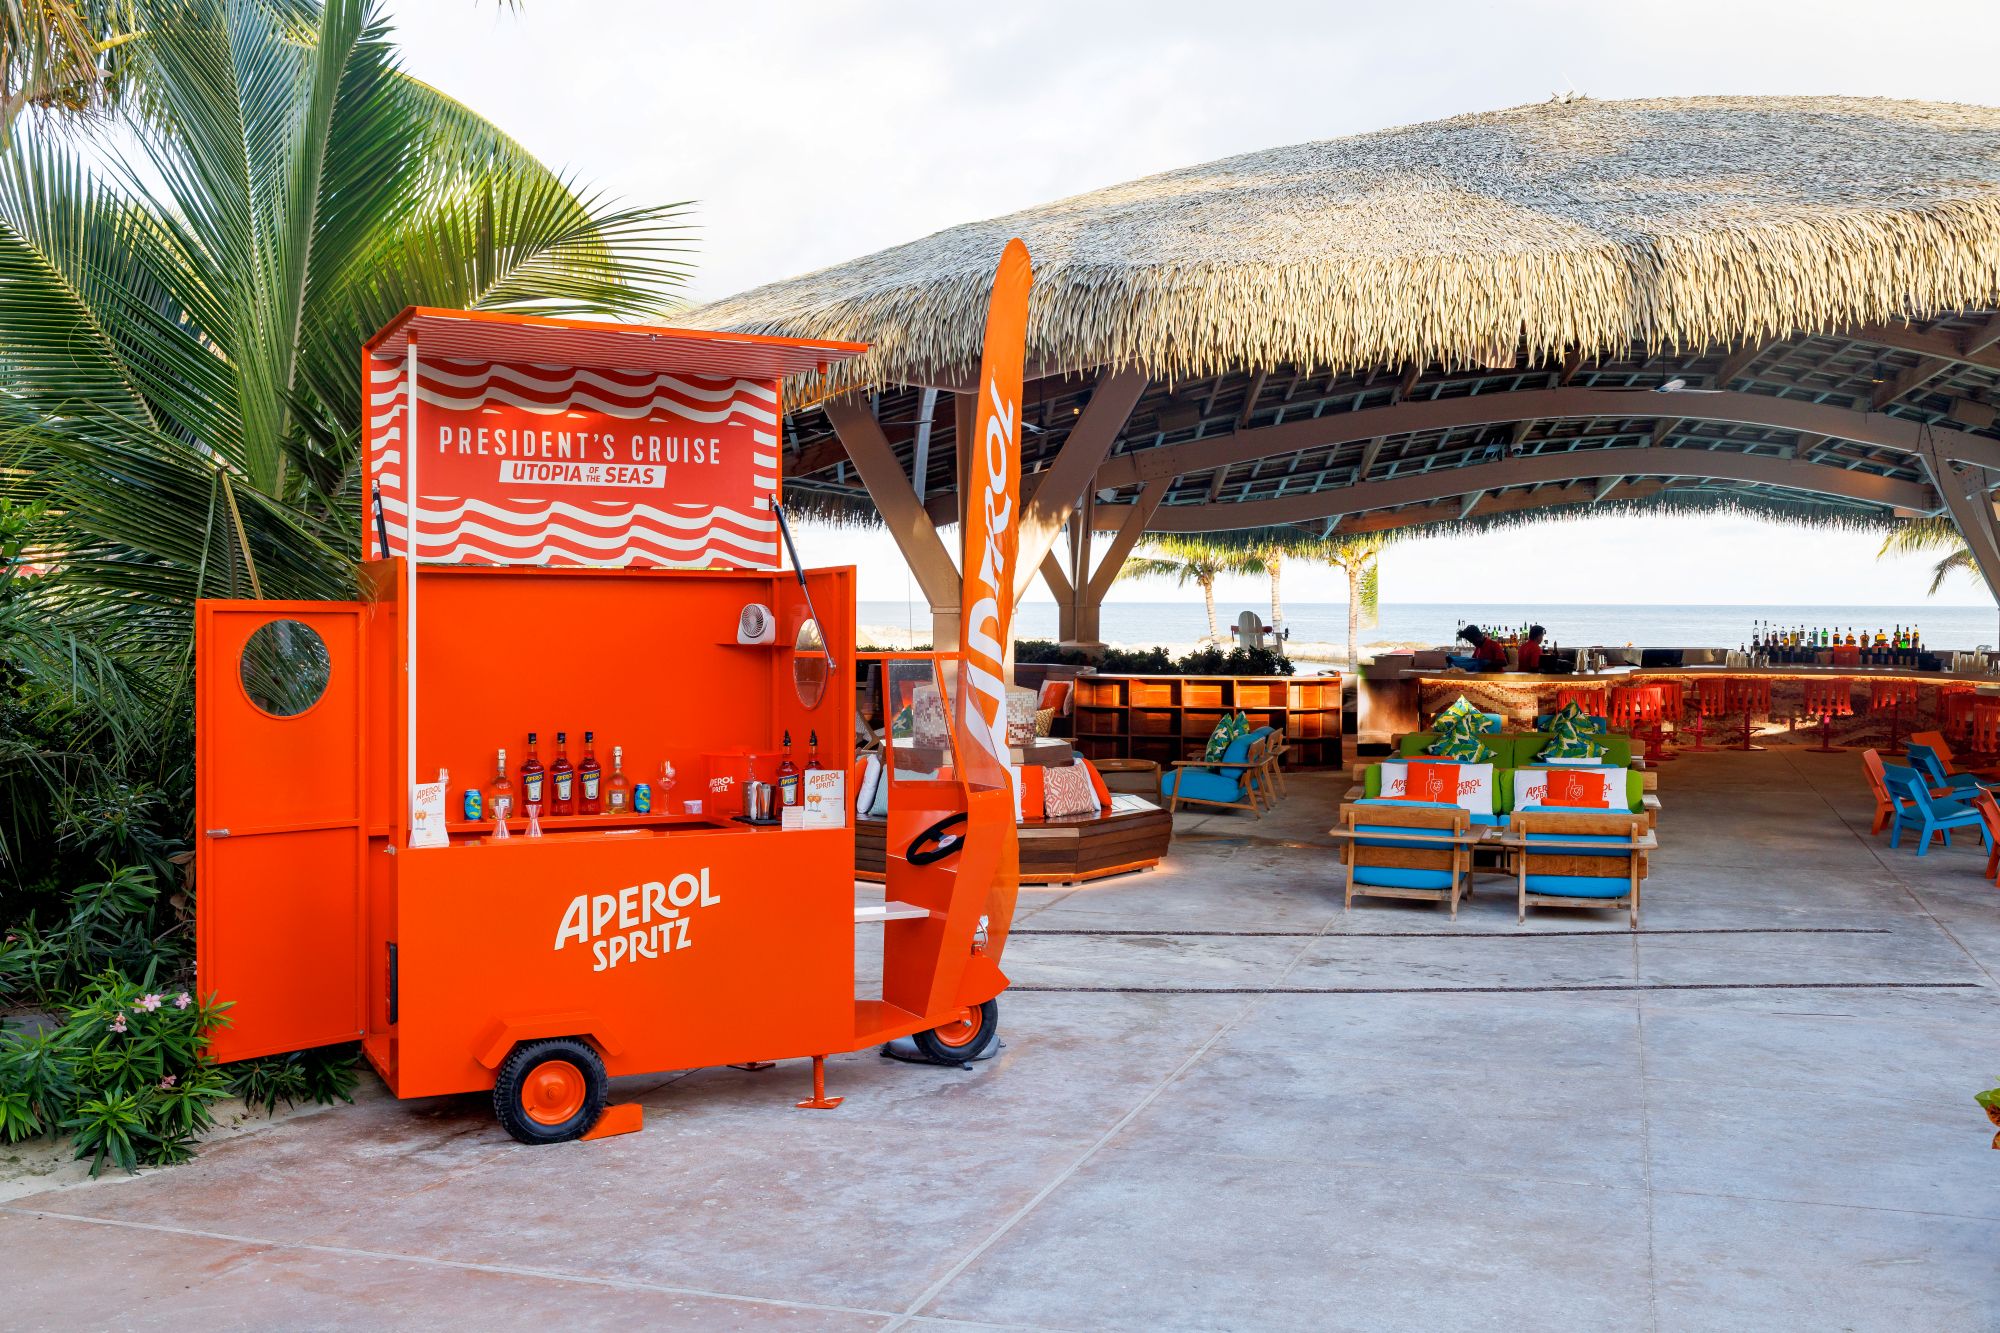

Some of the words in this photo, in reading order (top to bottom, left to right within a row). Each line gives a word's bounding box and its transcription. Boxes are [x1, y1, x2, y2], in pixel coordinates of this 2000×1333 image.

[439, 425, 615, 461] PRESIDENT'S
[631, 434, 721, 465] CRUISE
[512, 463, 582, 482] UTOPIA
[588, 466, 600, 474] OF
[604, 466, 654, 485] SEAS
[586, 474, 601, 483] THE
[809, 771, 841, 785] APEROL
[815, 781, 835, 790] SPRITZ
[1456, 778, 1482, 790] PEROL
[416, 785, 442, 800] APEROL
[553, 867, 721, 951] APEROL
[592, 916, 692, 972] SPRITZ
